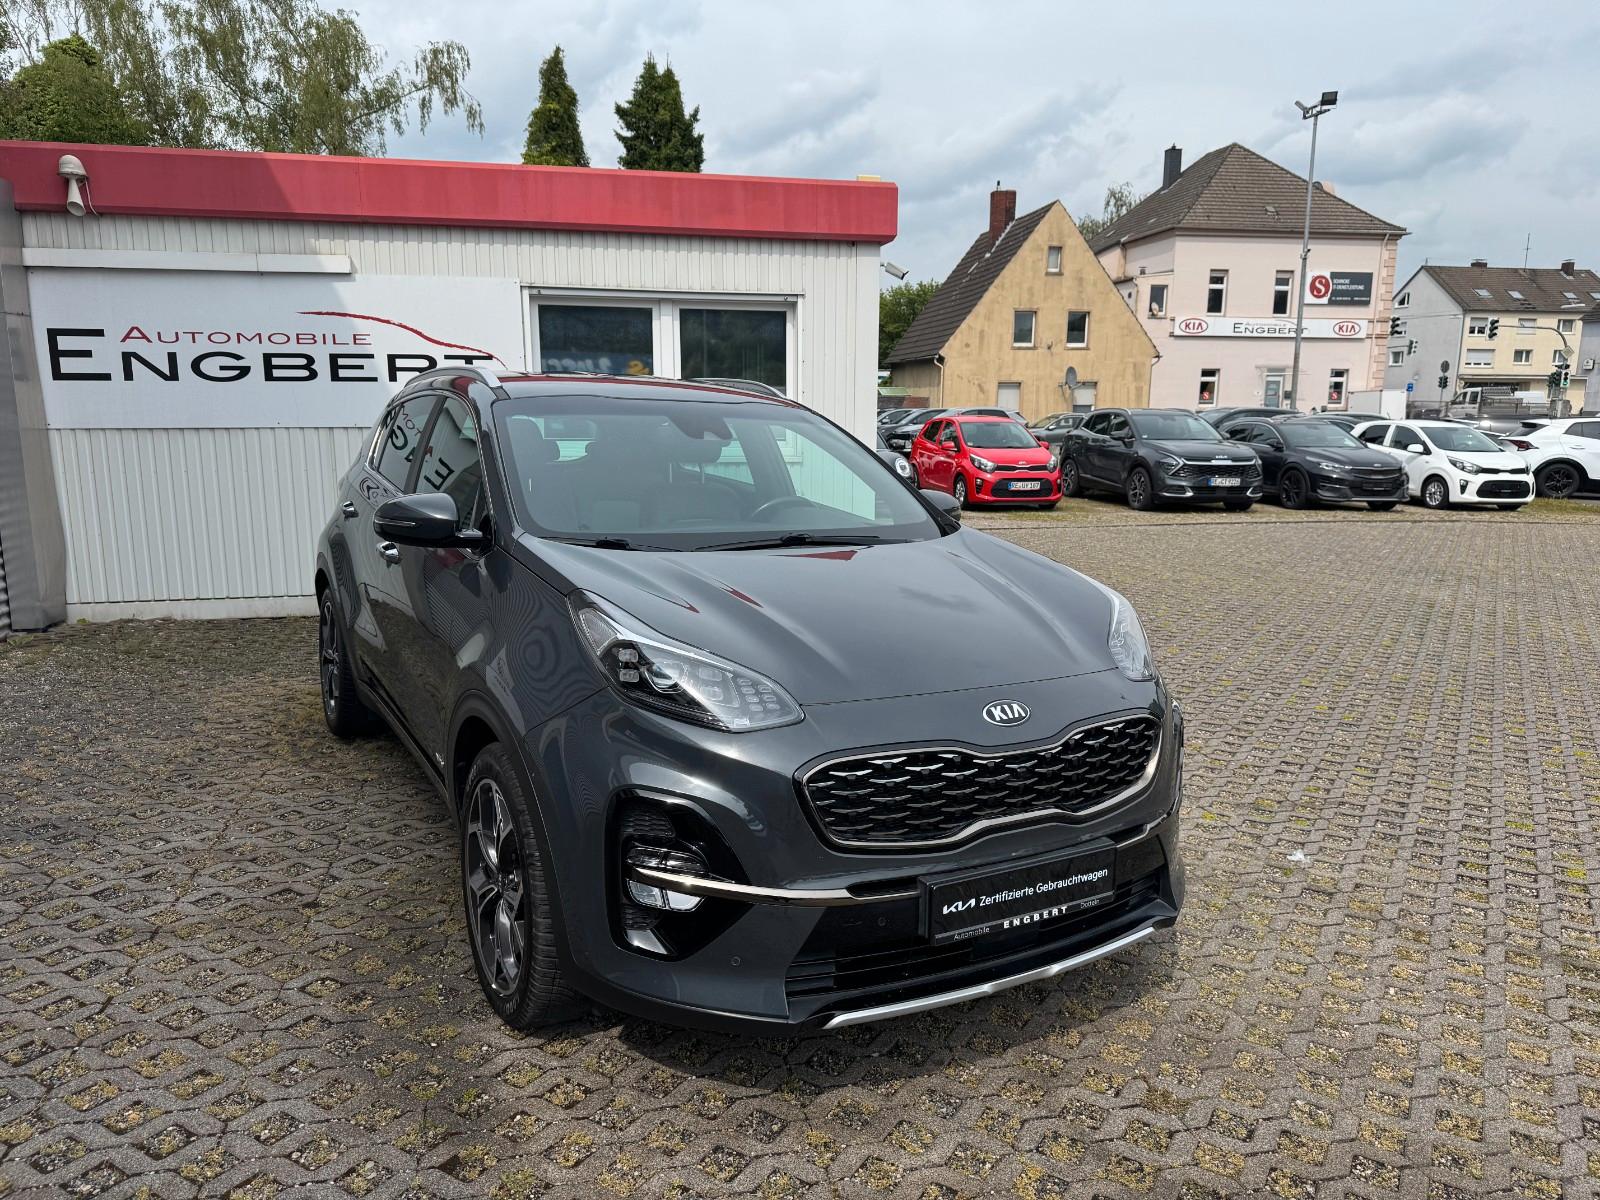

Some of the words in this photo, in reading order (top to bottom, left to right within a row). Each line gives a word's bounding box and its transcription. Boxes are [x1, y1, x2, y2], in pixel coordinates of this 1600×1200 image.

[1313, 278, 1326, 296] S
[120, 326, 373, 346] AUTOMOBILE
[989, 703, 1026, 721] KIA
[979, 886, 1034, 907] Zertifizierte
[1036, 869, 1108, 894] Gebrauchtwagen
[954, 926, 990, 940] Automobile
[1003, 906, 1068, 929] ENGBERT
